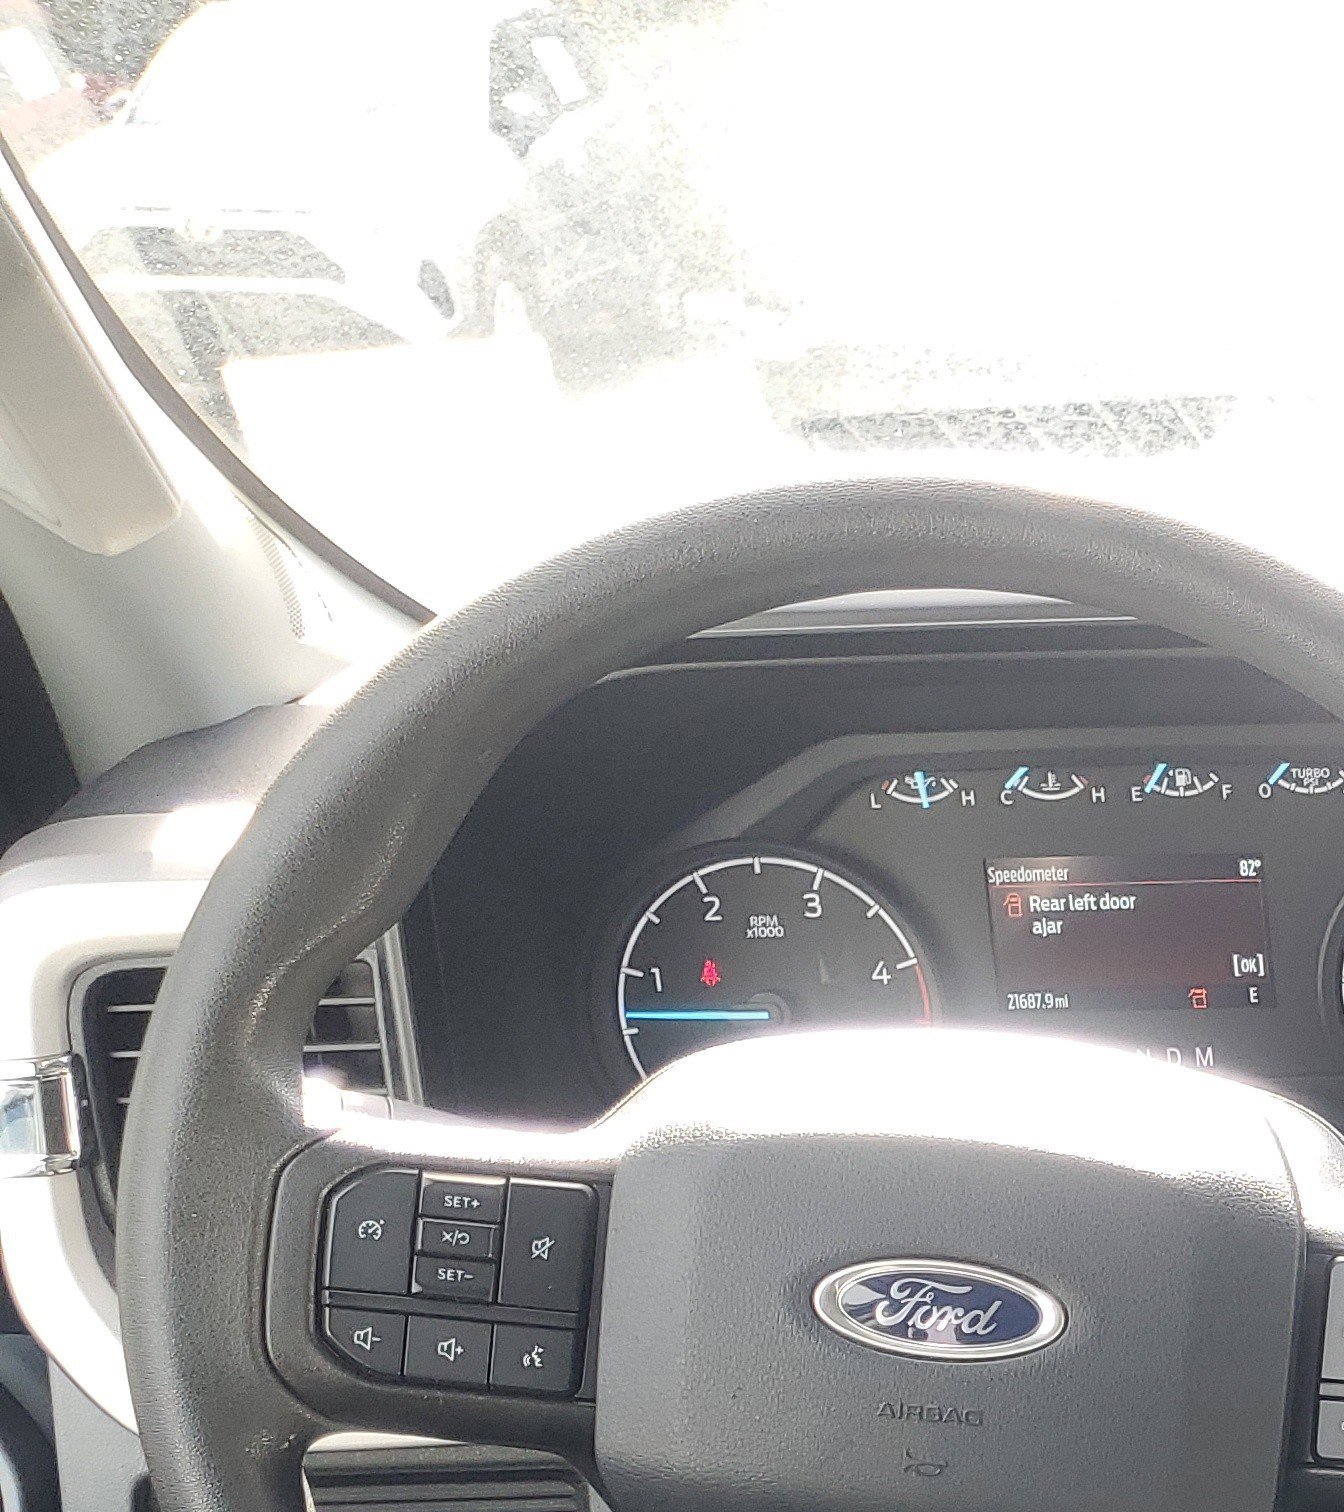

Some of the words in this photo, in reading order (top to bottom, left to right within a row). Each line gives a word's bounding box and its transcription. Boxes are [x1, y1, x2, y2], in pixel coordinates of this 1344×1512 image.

[1291, 767, 1330, 779] TURBO
[1303, 778, 1319, 787] PSI
[961, 789, 975, 806] H
[1000, 790, 1014, 805] C
[1091, 787, 1105, 803] H
[1131, 787, 1143, 801] E
[1221, 784, 1232, 800] F
[870, 793, 881, 809] L
[988, 867, 1069, 885] Speedometer
[1238, 858, 1261, 877] 82°
[703, 896, 723, 921] 2
[803, 893, 822, 917] 3
[1029, 894, 1066, 912] Rear
[1069, 893, 1097, 911] left
[1099, 892, 1136, 911] door
[750, 915, 778, 928] RPM
[1032, 918, 1063, 937] ajar
[746, 925, 784, 939] x1000
[650, 967, 662, 992] 1
[871, 961, 891, 985] 4
[1007, 993, 1053, 1010] 21687.9
[1249, 987, 1259, 1003] E
[1195, 1046, 1214, 1067] M
[444, 1195, 480, 1209] SET+
[437, 1267, 474, 1282] SET-
[875, 1278, 1003, 1335] Ford
[876, 1401, 984, 1426] AIRBAG
